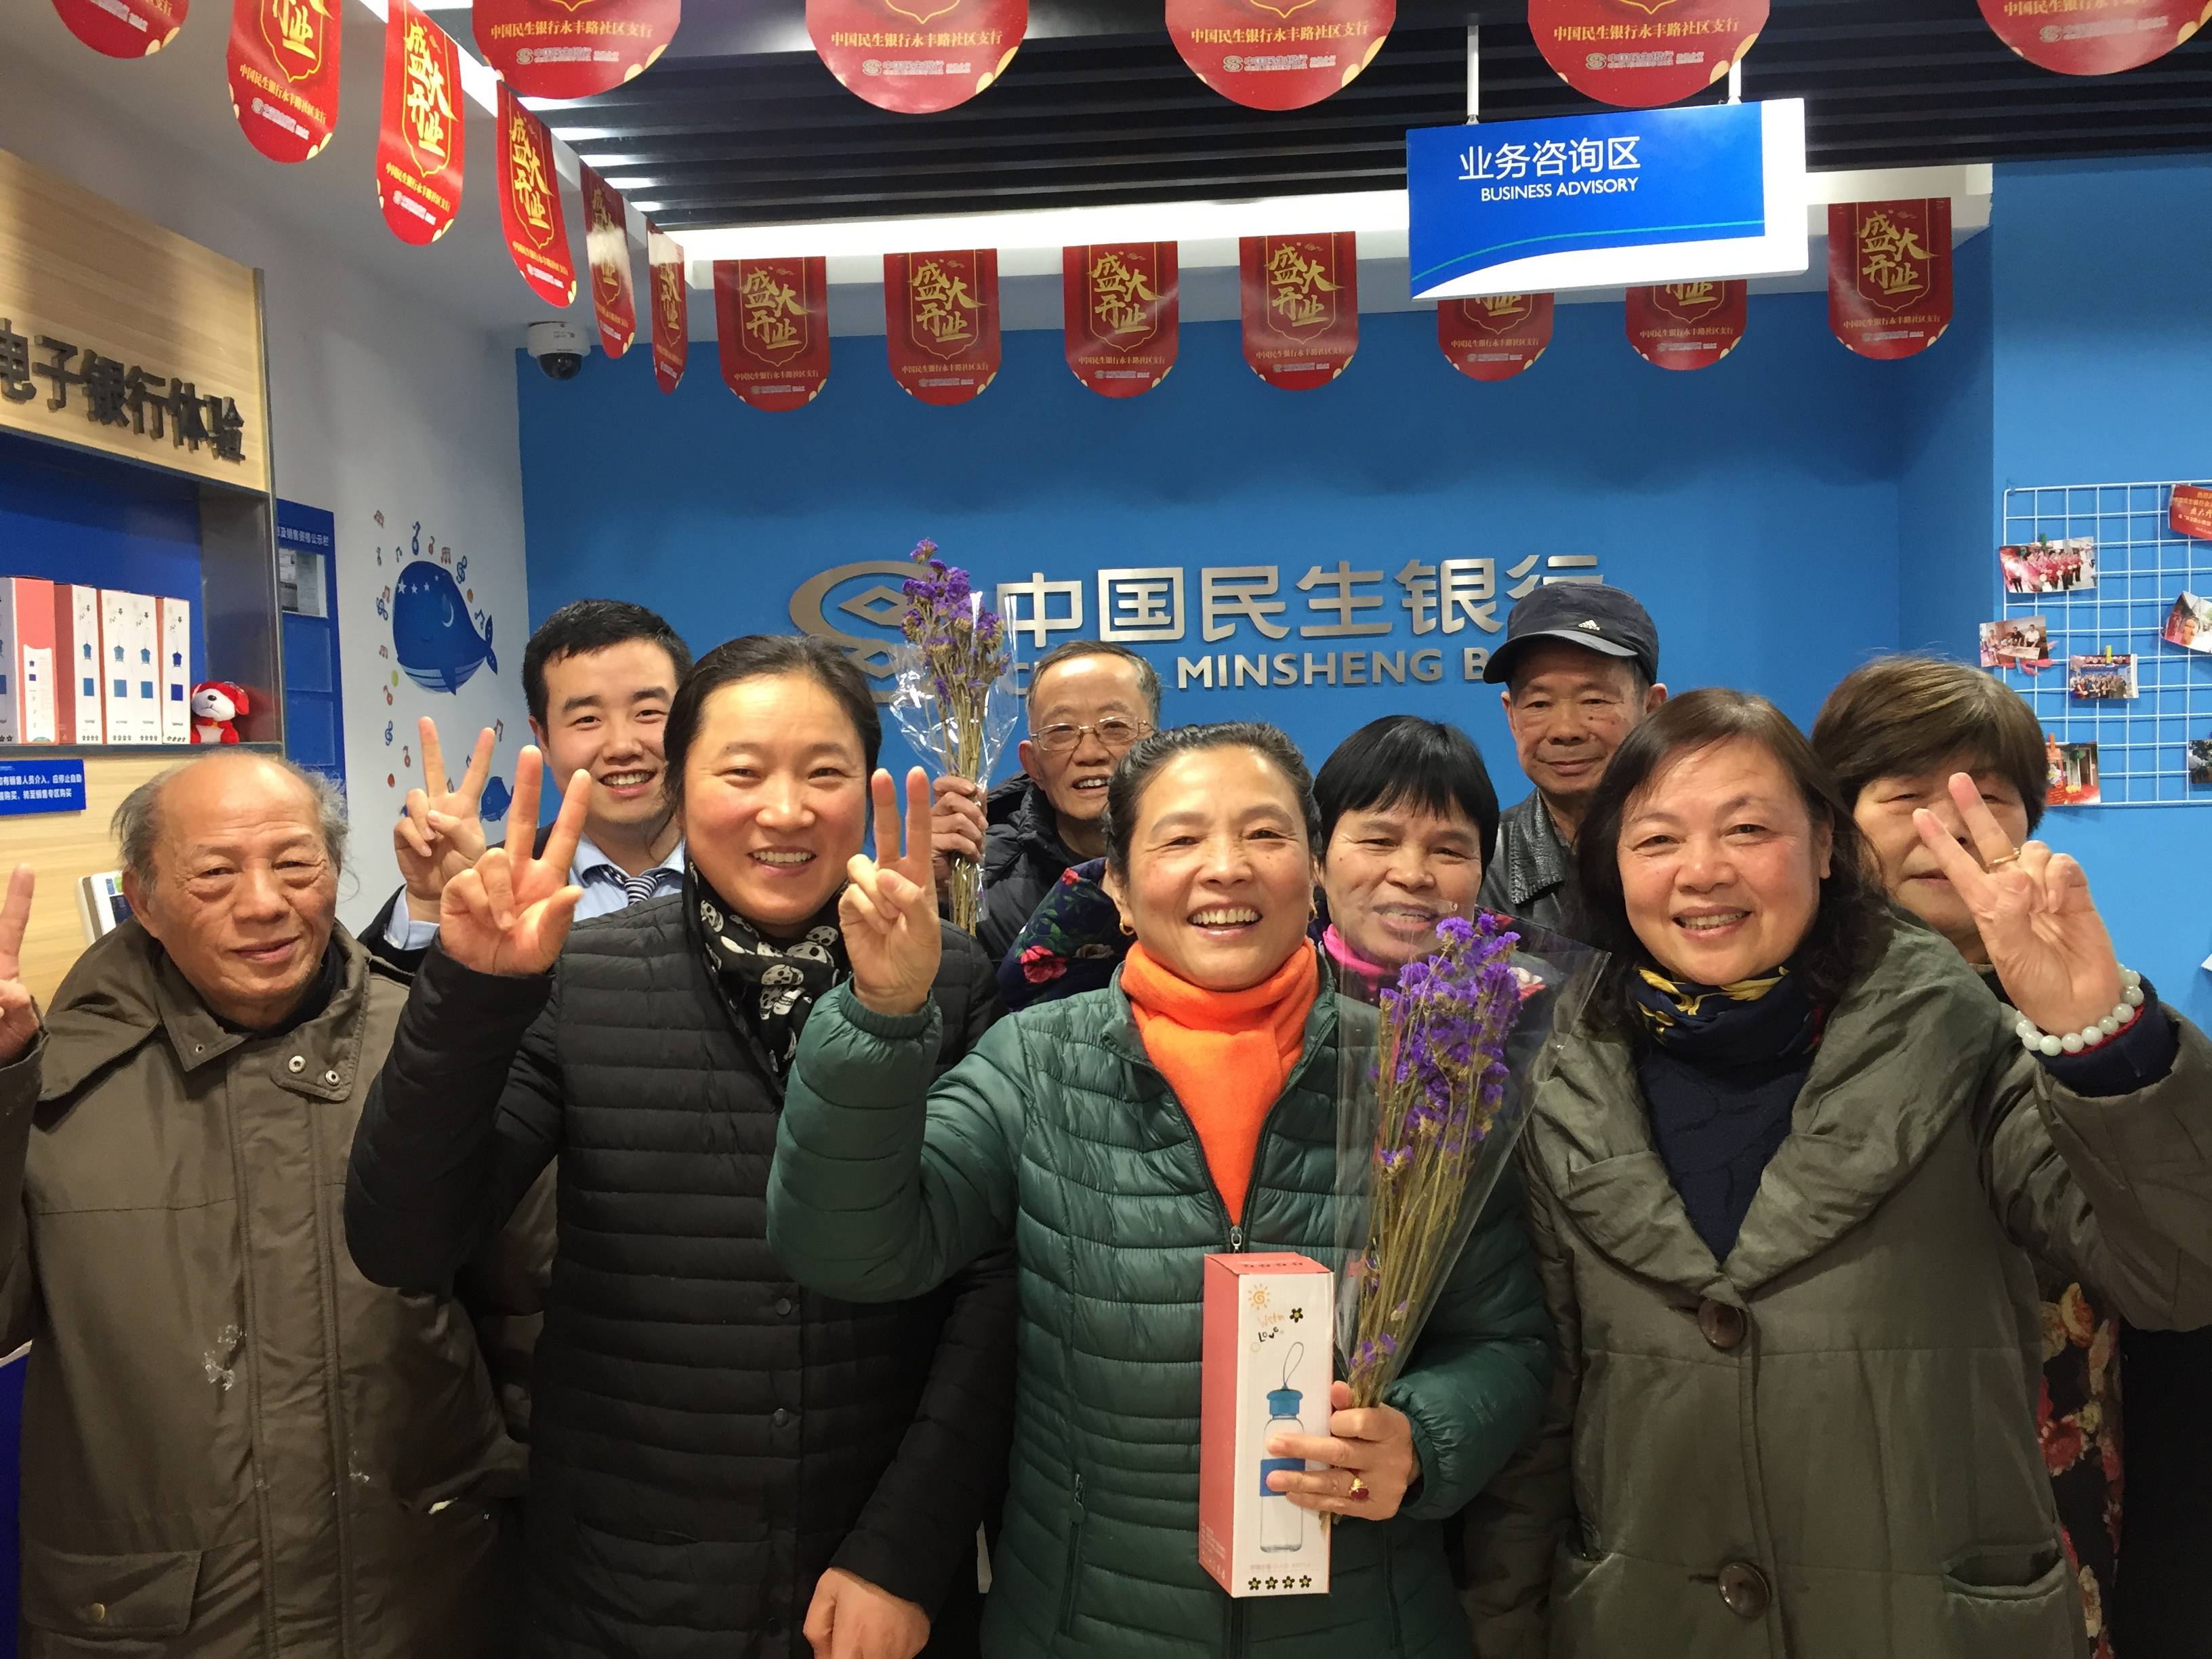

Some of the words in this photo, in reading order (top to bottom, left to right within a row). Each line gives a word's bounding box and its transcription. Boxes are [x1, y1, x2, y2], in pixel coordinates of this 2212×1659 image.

[491, 20, 653, 39] 中国民生银行永丰路社区支行
[831, 30, 1002, 48] 中国民生银行永丰路社区支行
[1191, 21, 1369, 44] 中国民生银行永丰路社区支行
[1553, 18, 1740, 41] 中国民生银行永丰路社区支行
[407, 81, 445, 157] 开业
[1458, 136, 1641, 180] 业务咨询区
[1481, 183, 1552, 202] BUSINESS
[1556, 177, 1639, 197] ADVISORY
[1857, 211, 1937, 262] 盛大
[909, 260, 984, 310] 盛大
[1088, 251, 1163, 302] 盛大
[1265, 243, 1342, 293] 盛大
[1862, 254, 1924, 295] 开业
[737, 267, 812, 317] 盛大
[1272, 287, 1330, 327] 开业
[745, 310, 802, 350] 开业
[916, 302, 972, 342] 开业
[1095, 294, 1151, 334] 开业
[0, 317, 245, 465] 电子银行体验
[997, 554, 1603, 647] 中国民生银行
[1178, 648, 1442, 689] MINSHENG
